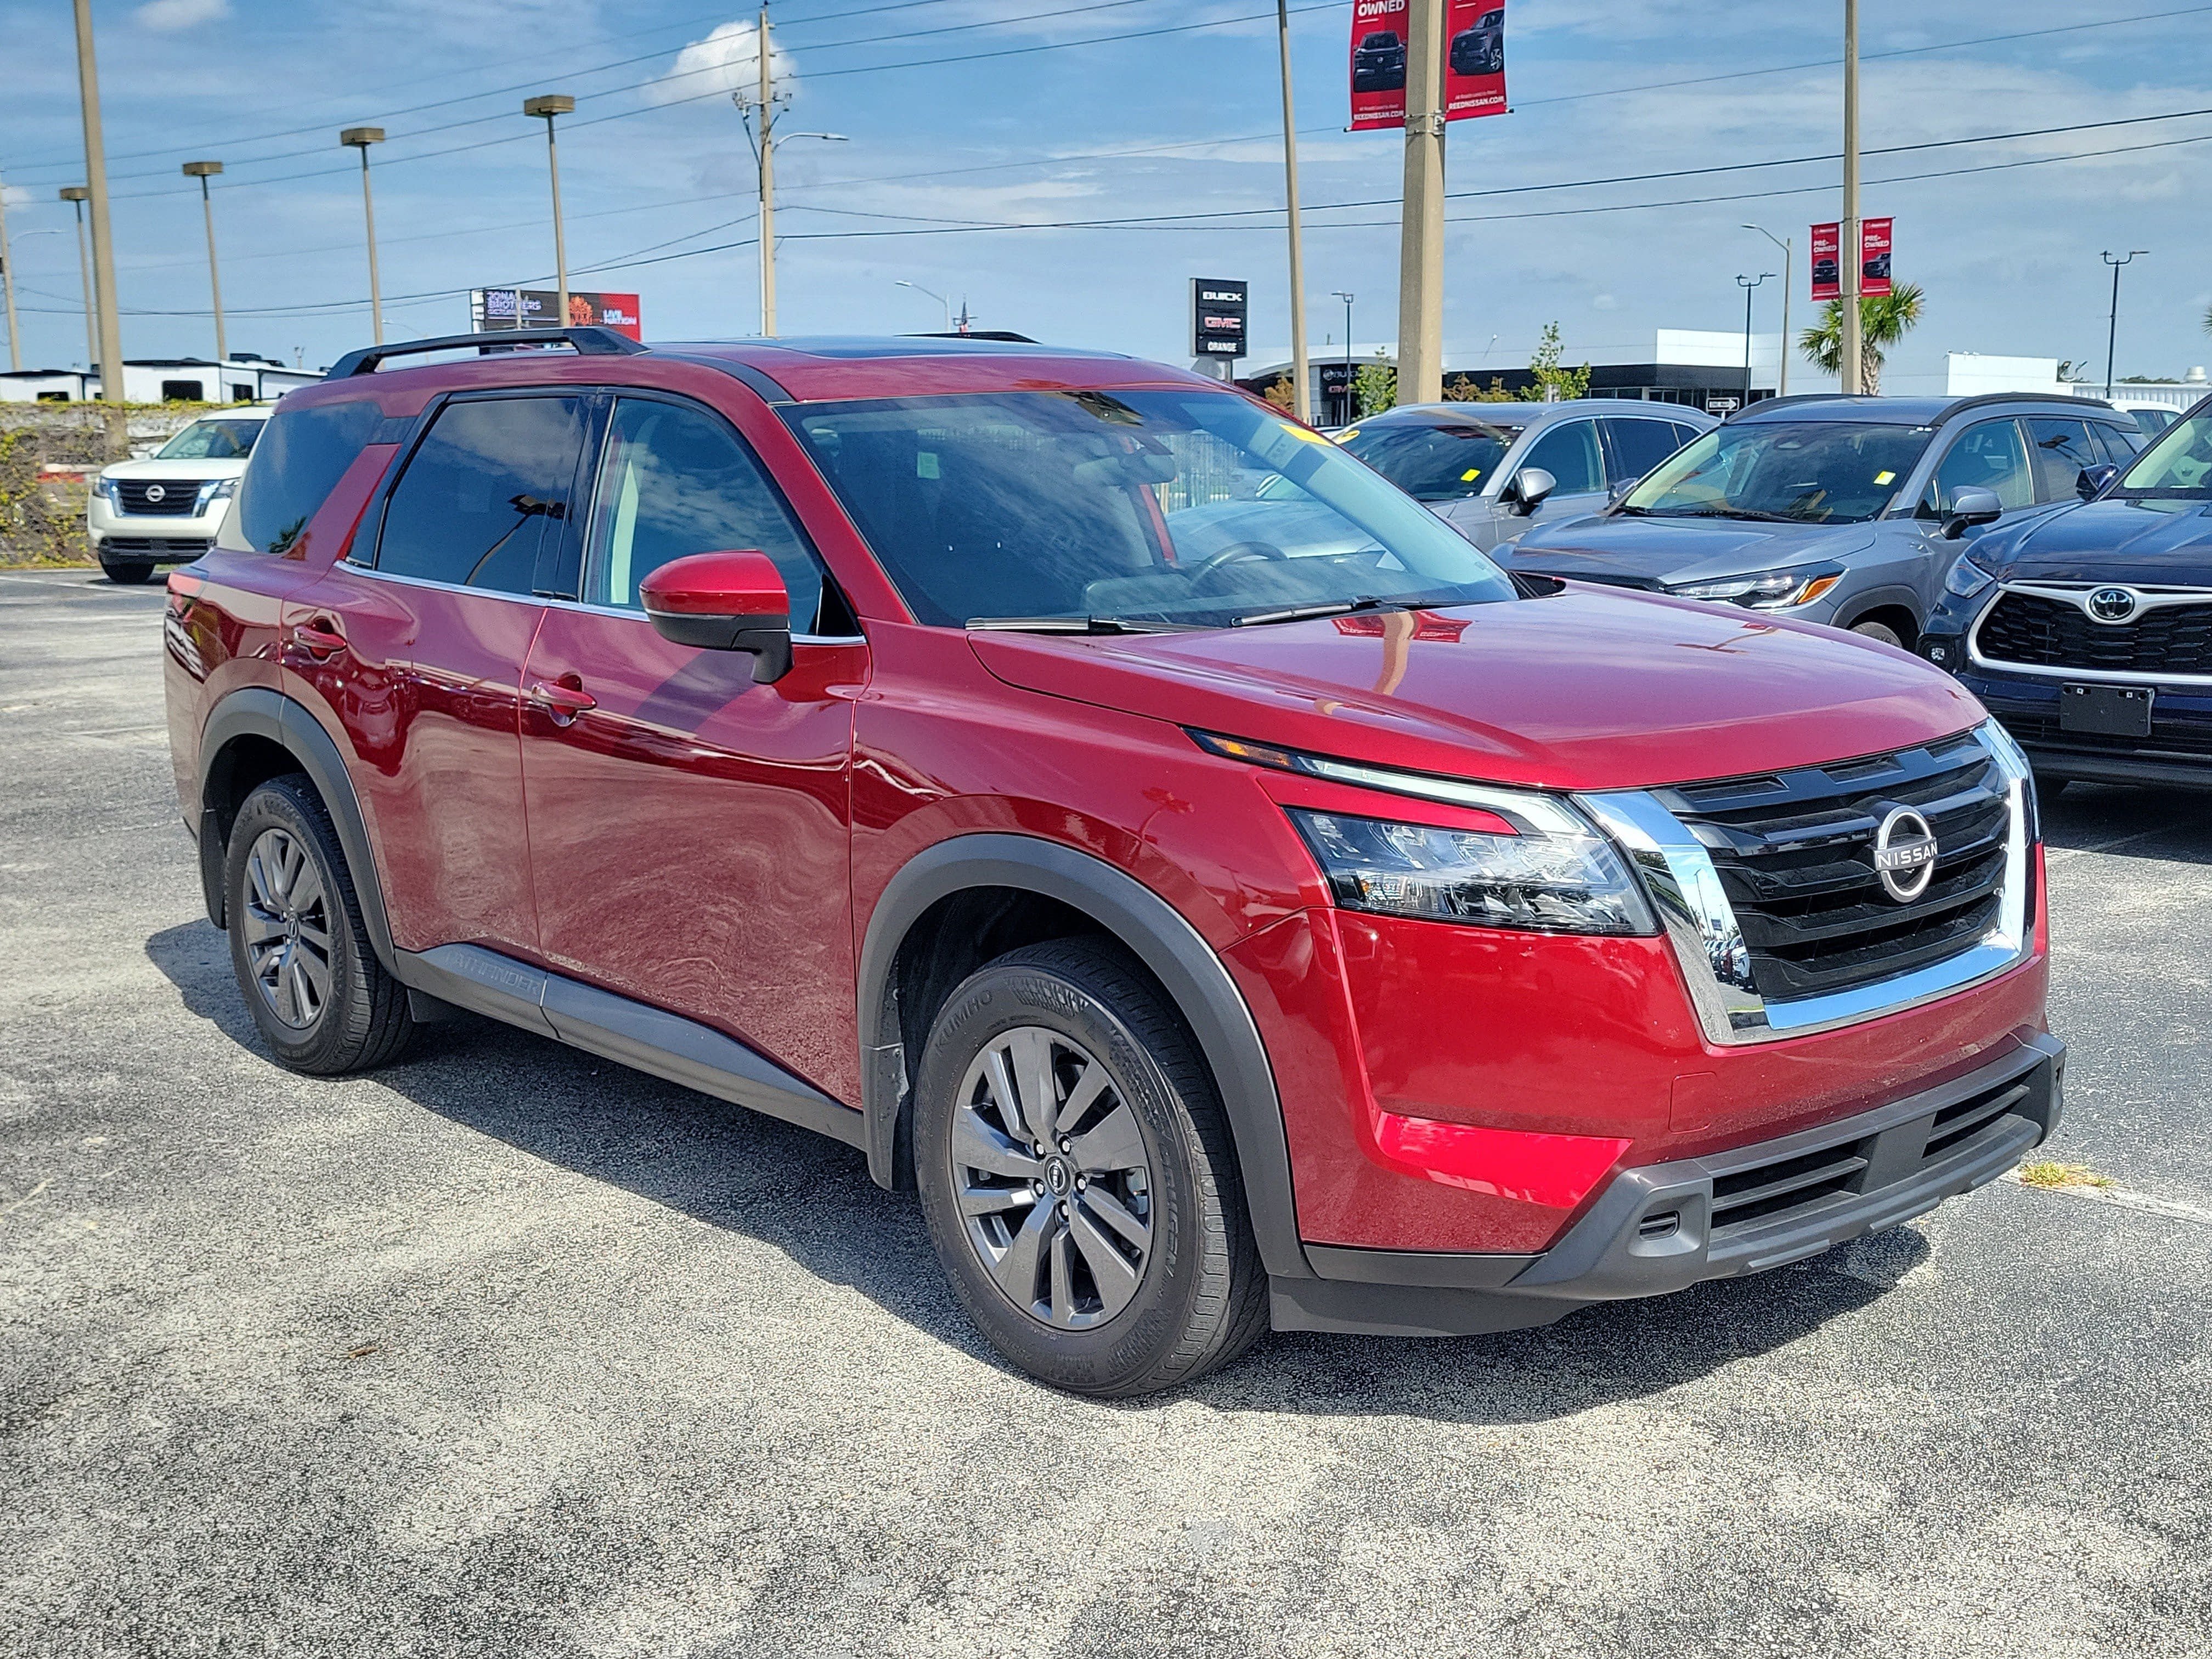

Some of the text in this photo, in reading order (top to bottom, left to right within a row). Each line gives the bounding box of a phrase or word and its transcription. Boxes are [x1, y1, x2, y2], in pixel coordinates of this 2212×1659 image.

[1358, 0, 1406, 17] OWNED
[1202, 291, 1243, 302] BUICK
[1204, 316, 1241, 329] GMC
[1878, 841, 1938, 868] NISSAN
[445, 952, 541, 995] PATHFINDER
[935, 990, 994, 1057] KUMHO
